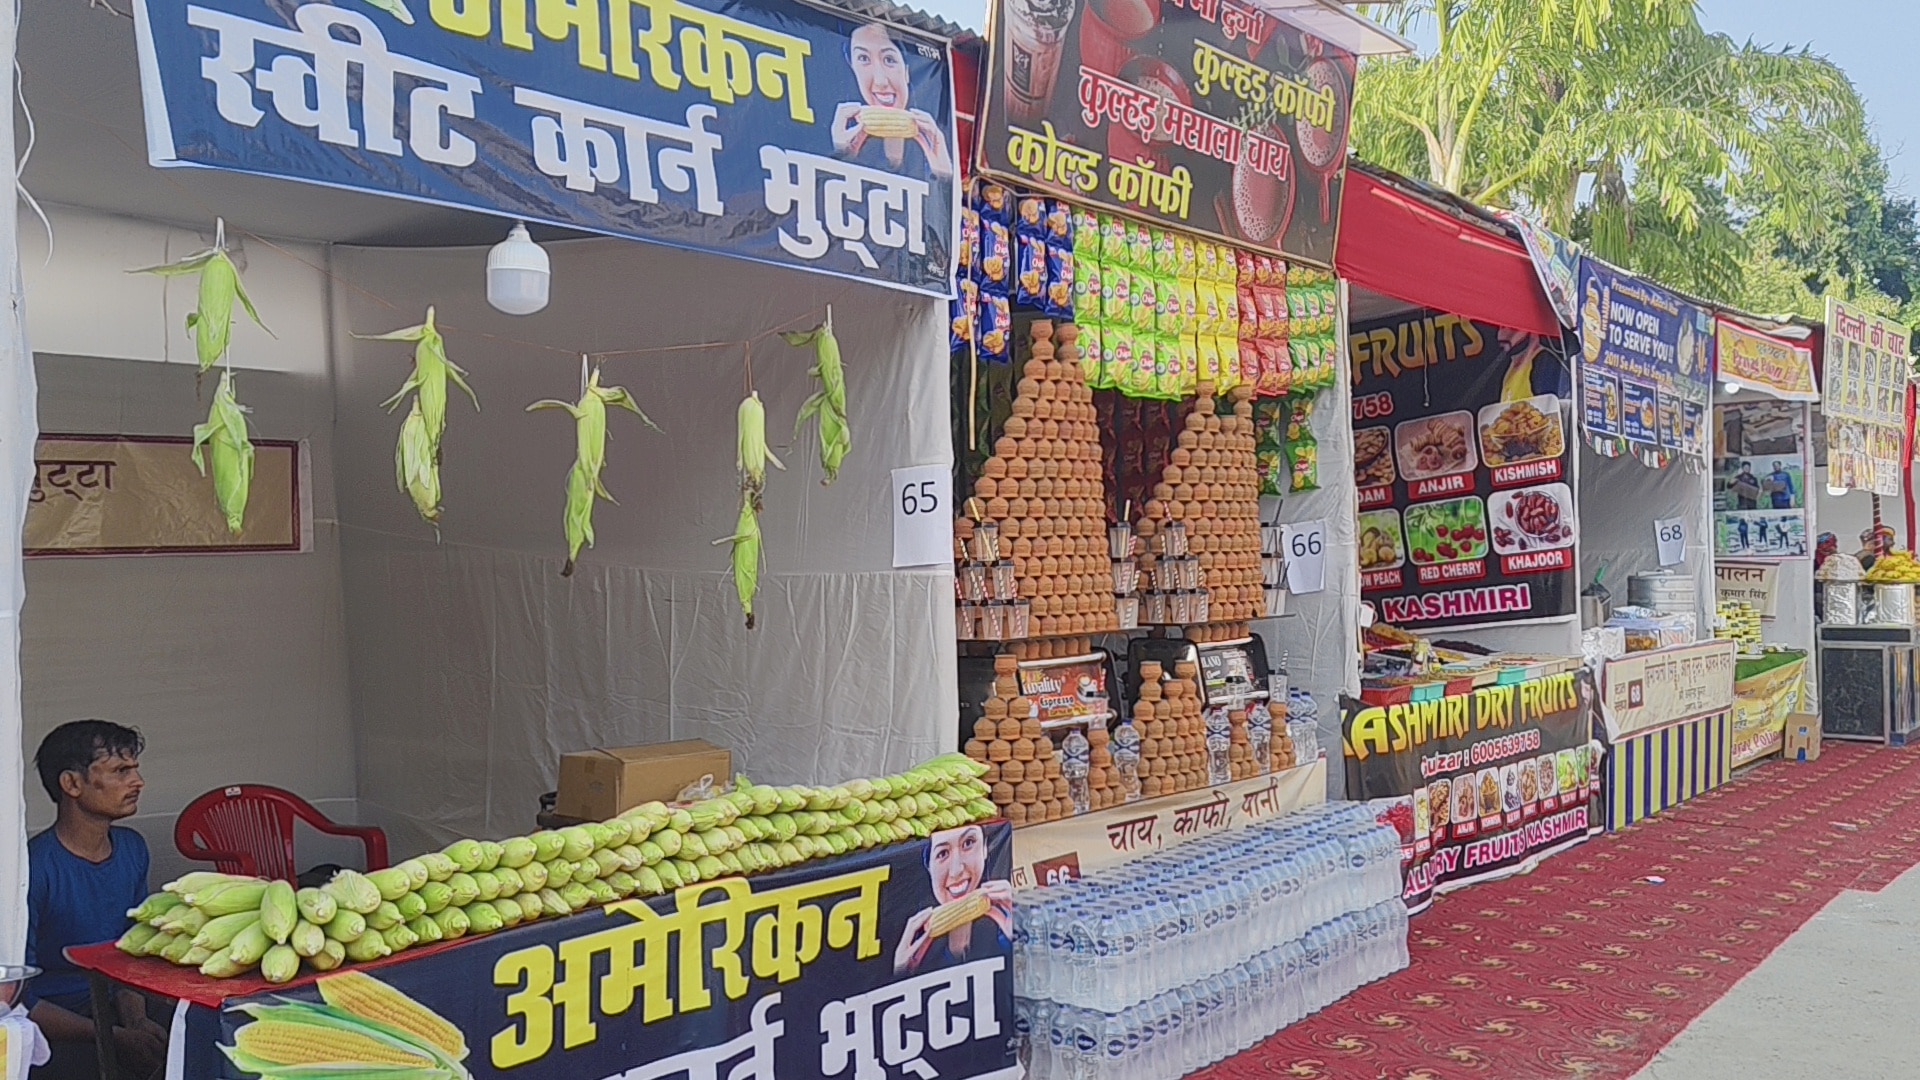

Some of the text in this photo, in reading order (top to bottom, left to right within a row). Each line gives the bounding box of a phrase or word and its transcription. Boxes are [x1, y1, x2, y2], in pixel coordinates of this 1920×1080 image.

[1221, 1, 1265, 45] दुर्गा
[1192, 39, 1336, 133] कुल्हड़ कॉफी
[187, 4, 929, 269] स्वीट कार्न भुट्टा
[1078, 65, 1161, 144] कुल्हड़
[1162, 100, 1243, 164] मसाला
[1246, 131, 1290, 181] चाय
[1007, 121, 1193, 219] कोल्ड कॉफी
[1610, 301, 1635, 327] NOW
[1635, 310, 1660, 337] OPEN
[1835, 303, 1905, 356] दिल्ली की चाट
[1350, 313, 1484, 385] FRUITS
[1609, 324, 1622, 346] TO
[1623, 330, 1651, 356] SERVE
[30, 460, 117, 502] ुट्टा
[1418, 475, 1465, 495] ANJIR
[1494, 460, 1557, 483] KISHMISH
[901, 481, 939, 515] 65
[1292, 531, 1322, 558] 66
[1660, 523, 1684, 543] 68
[1374, 569, 1401, 586] PEACH
[1420, 560, 1482, 581] RED CHERRY
[1508, 552, 1564, 571] KHAJOOR
[1383, 583, 1531, 622] KASHMIRI
[1022, 676, 1063, 695] wality
[1475, 684, 1516, 730] DRY
[1521, 671, 1578, 724] FRUITS
[1471, 728, 1541, 764] 6005639758
[1242, 777, 1280, 818] पानी
[1464, 829, 1526, 869] FRUITS
[1525, 805, 1588, 848] KASHMIR
[491, 865, 890, 1069] अमेरिकन
[820, 957, 1005, 1080] भट्टा
